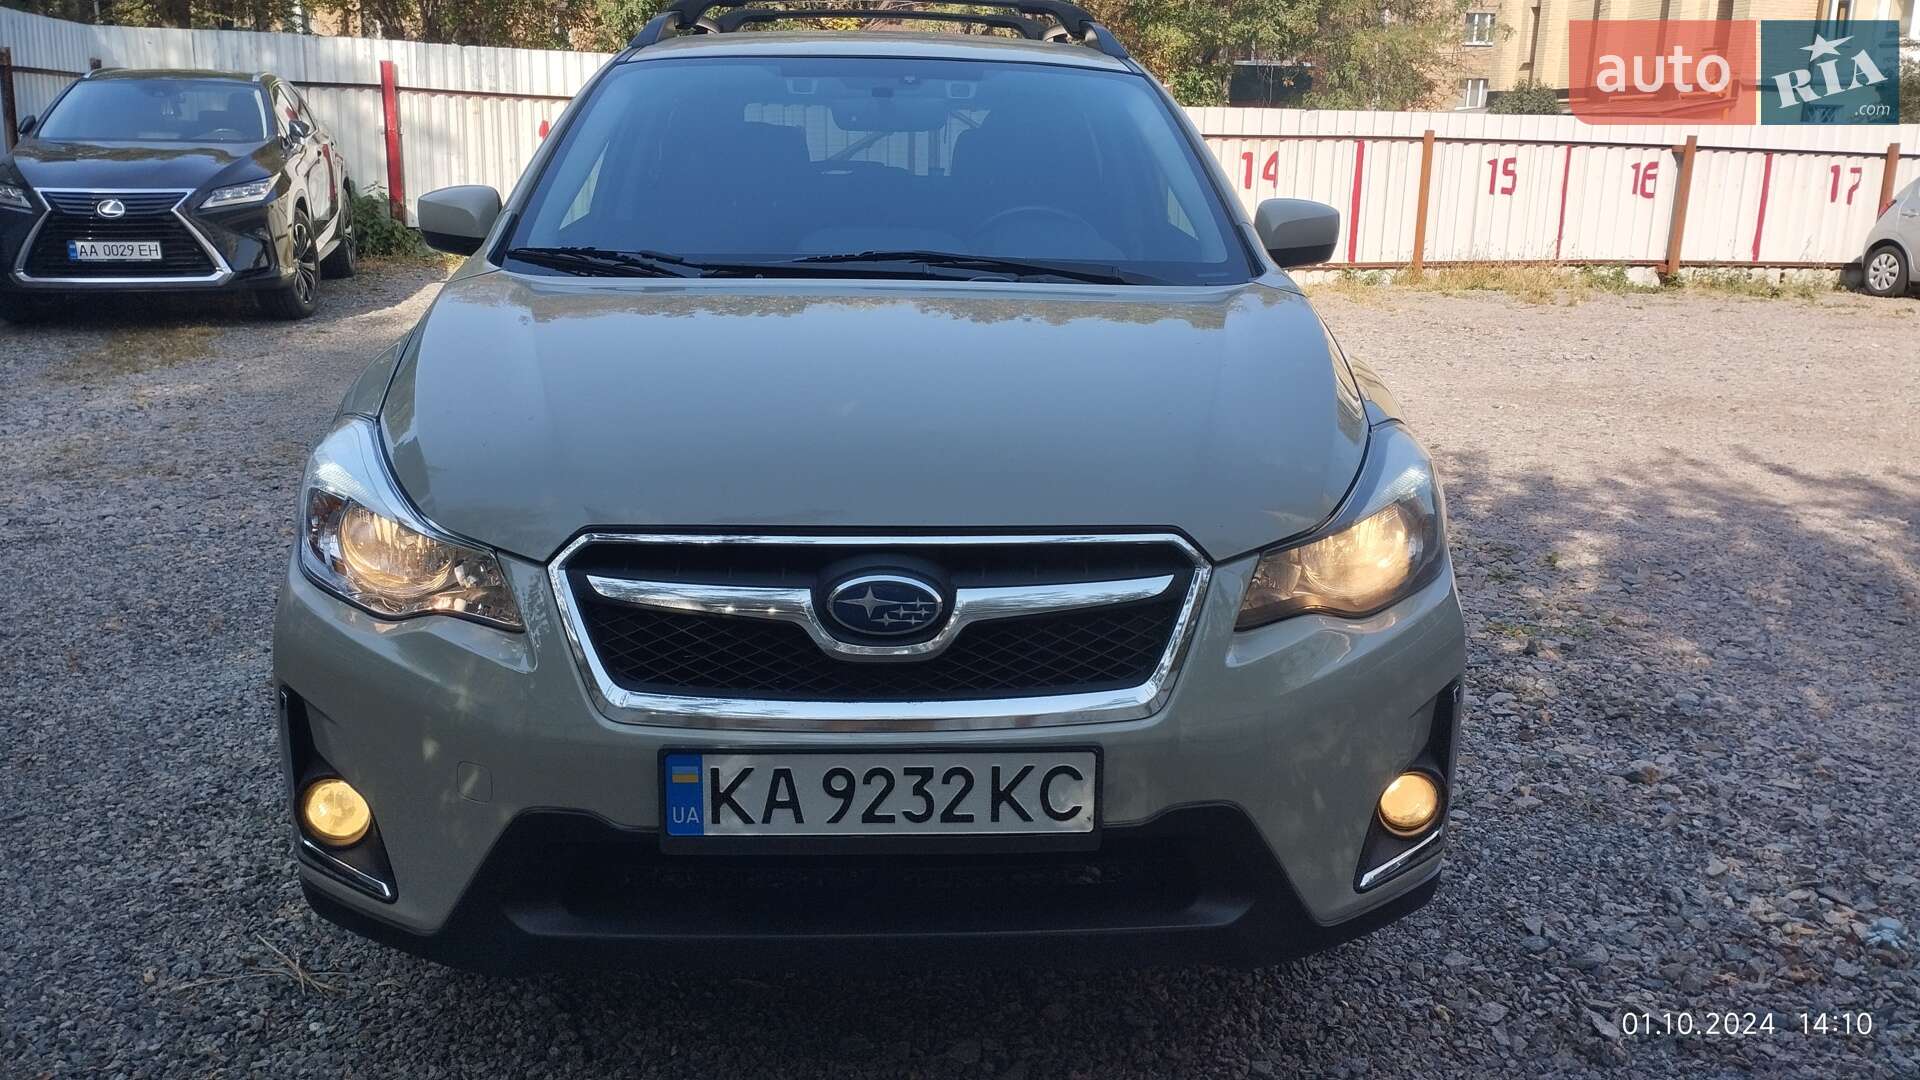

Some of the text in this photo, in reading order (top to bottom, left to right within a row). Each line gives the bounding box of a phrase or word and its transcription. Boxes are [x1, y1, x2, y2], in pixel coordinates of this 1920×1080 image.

[1241, 151, 1279, 190] 14
[1487, 157, 1518, 196] 15
[1631, 161, 1659, 199] 16
[1830, 165, 1862, 205] 17
[79, 244, 159, 257] AA 0029 EH
[709, 765, 1084, 825] KA 9232 KC
[672, 806, 700, 824] UA
